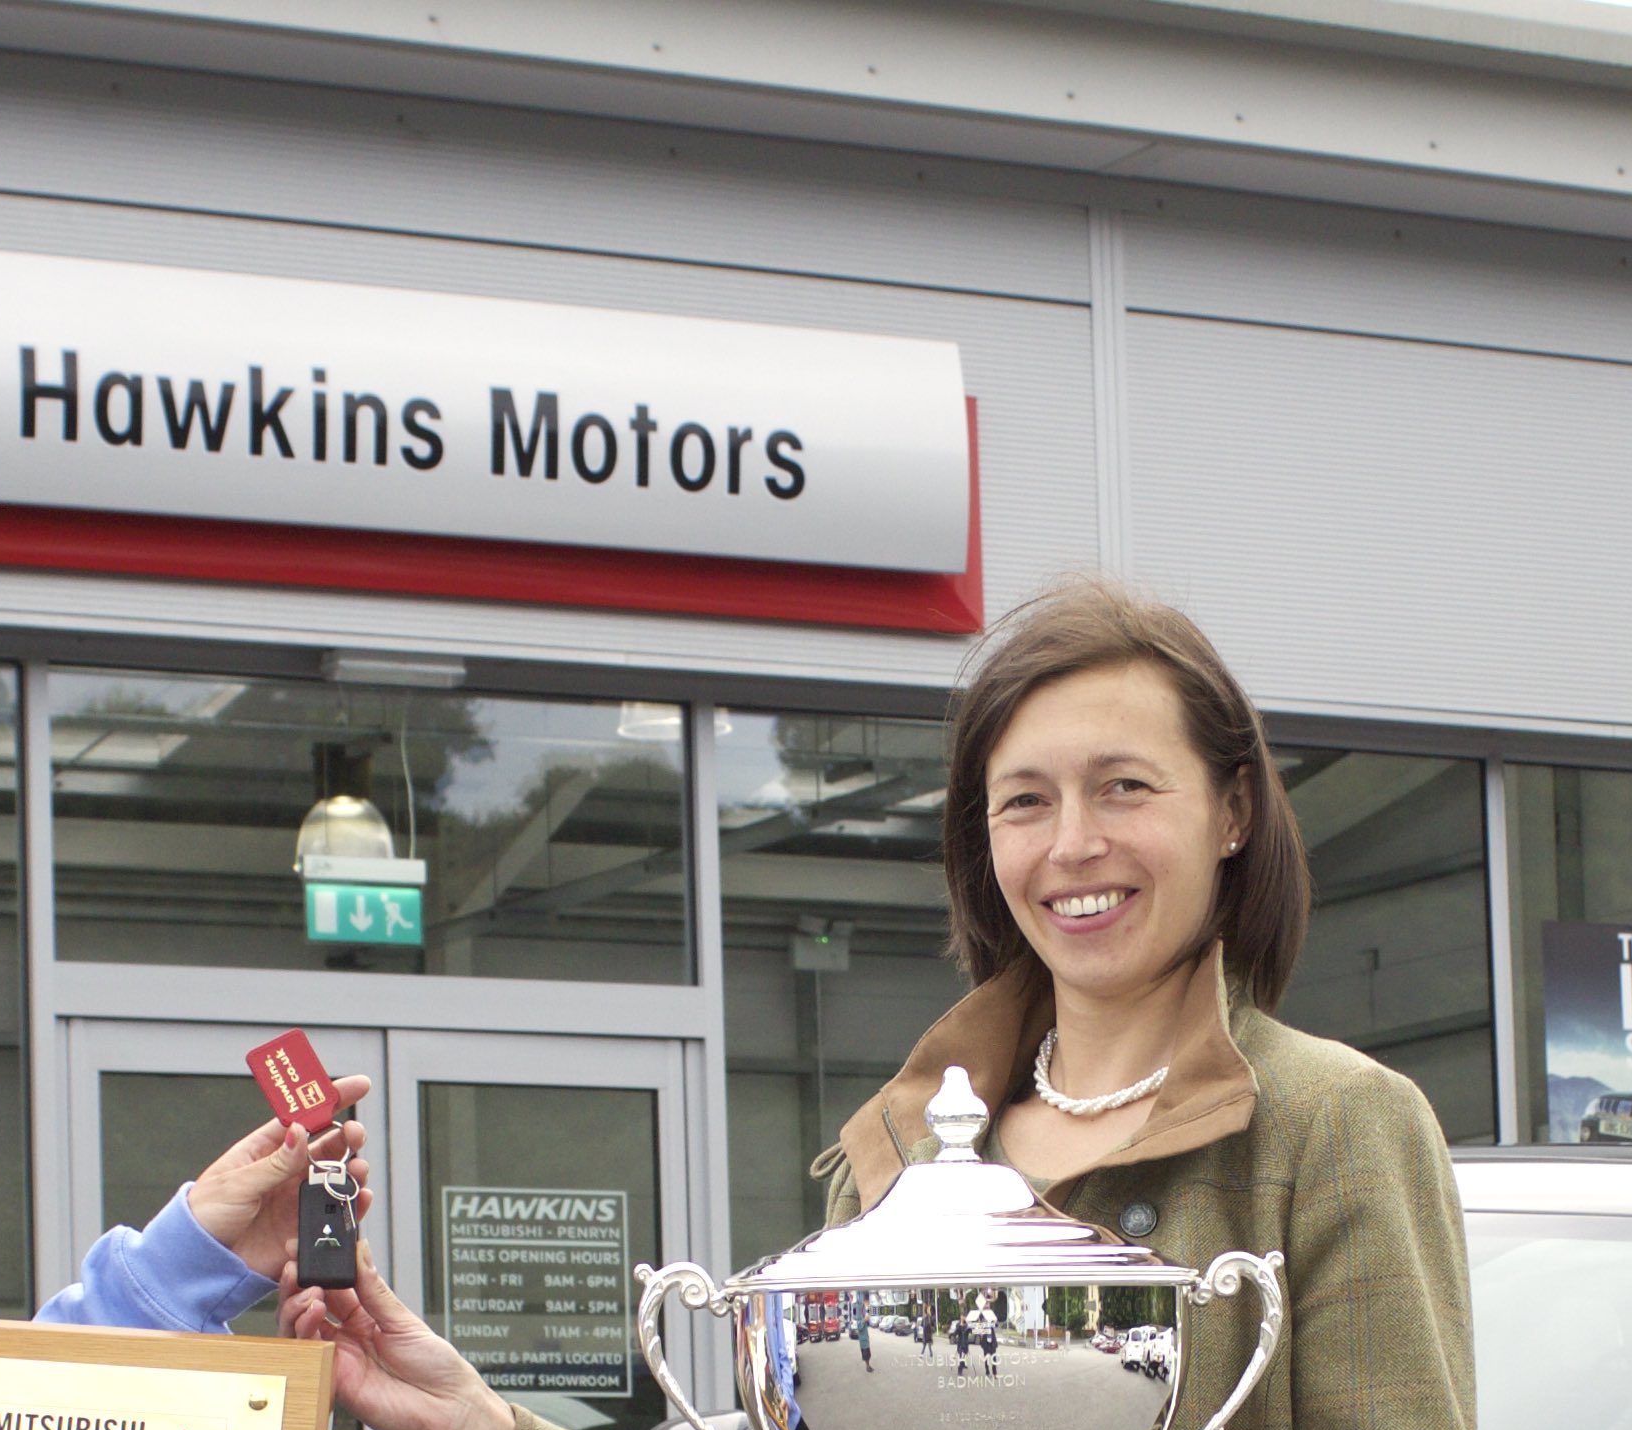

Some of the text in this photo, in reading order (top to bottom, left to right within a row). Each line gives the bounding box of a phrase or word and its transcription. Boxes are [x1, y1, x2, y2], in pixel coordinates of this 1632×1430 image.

[20, 344, 807, 501] Hawkins Motors
[450, 1195, 617, 1222] HAWKINS
[451, 1224, 543, 1239] MITSUBISHI
[557, 1225, 620, 1240] PENRYN
[452, 1248, 621, 1265] SALES OPENING HOURS
[453, 1273, 488, 1286] MON
[500, 1274, 524, 1287] FRI
[544, 1274, 575, 1288] 9AM
[587, 1275, 617, 1288] 6PM
[453, 1298, 525, 1313] SATURDAY
[545, 1300, 577, 1313] 9AM
[588, 1300, 619, 1314] 5PM
[453, 1325, 511, 1338] SUNDAY
[543, 1325, 581, 1339] 11AM
[592, 1326, 623, 1339] 4PM
[460, 1351, 624, 1365] ERVICE & PARTS LOCATED
[483, 1373, 620, 1387] EUGEOT SHOWROOM
